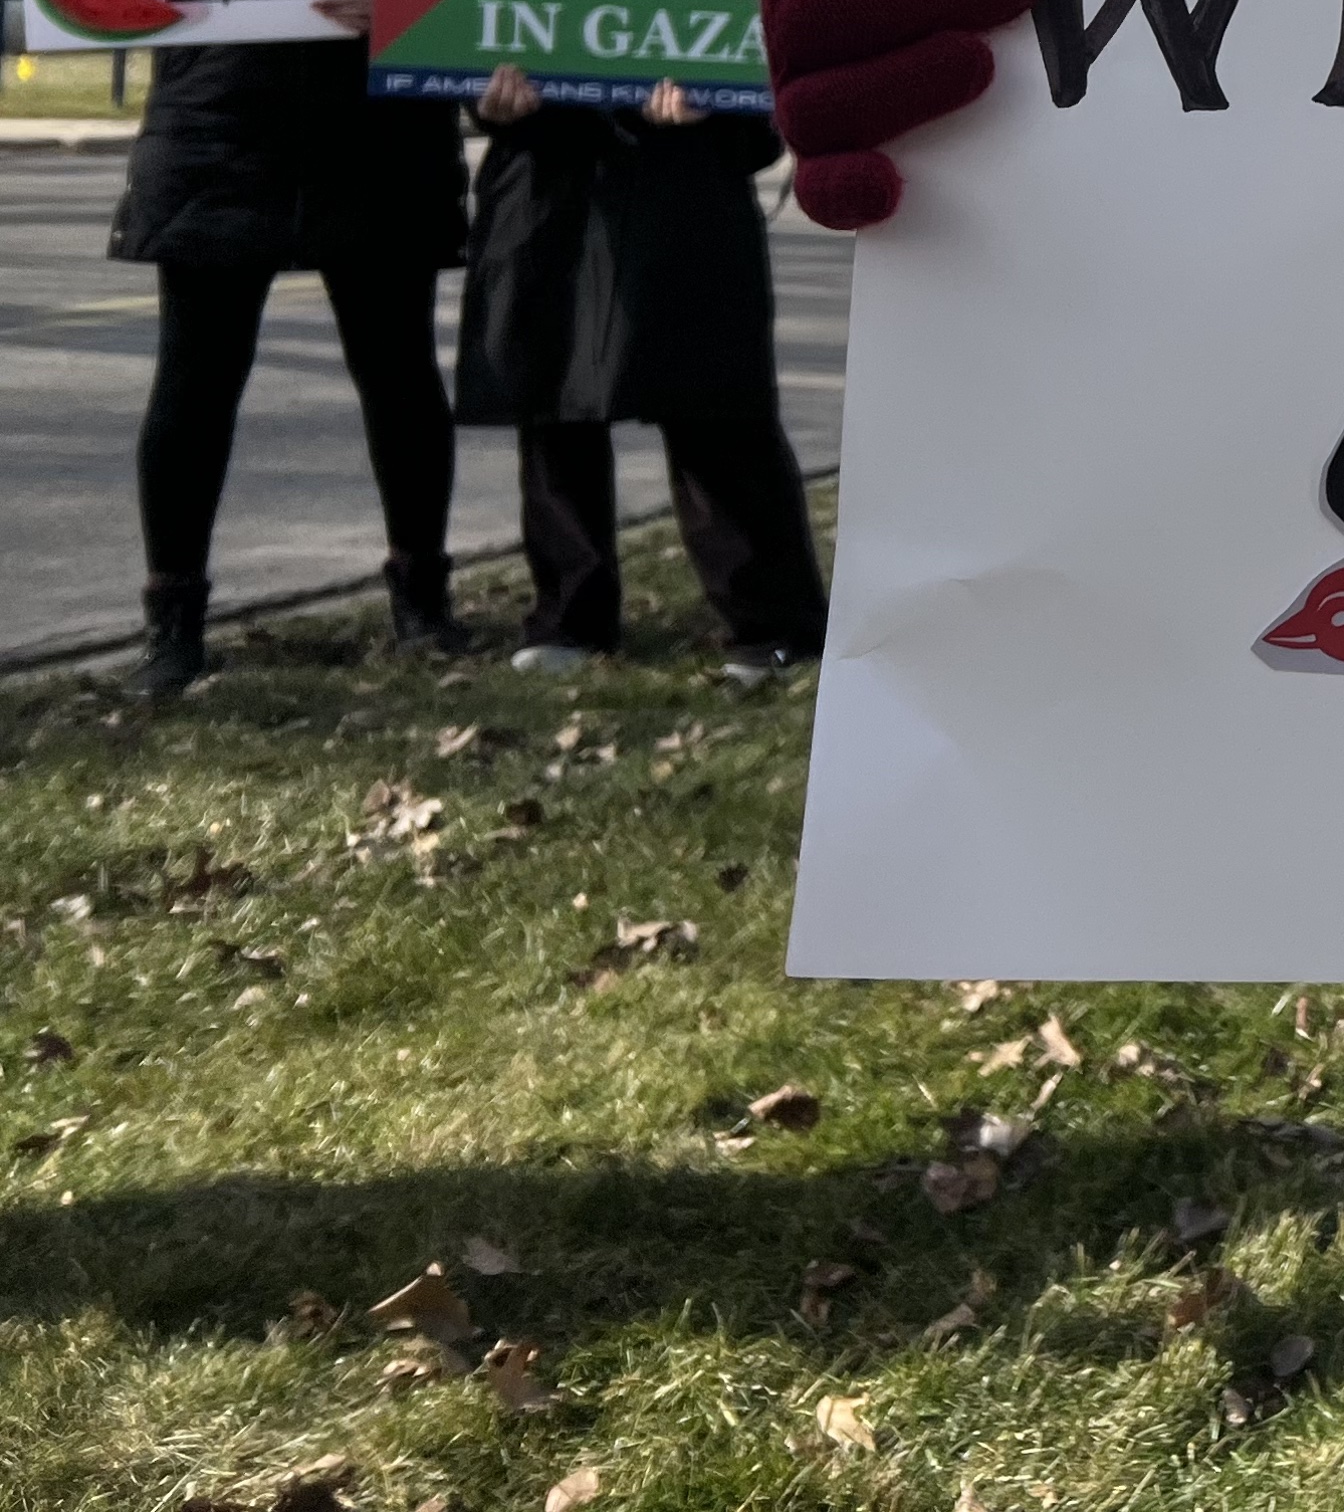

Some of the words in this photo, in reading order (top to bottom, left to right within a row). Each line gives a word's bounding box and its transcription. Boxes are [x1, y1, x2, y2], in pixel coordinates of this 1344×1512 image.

[477, 0, 563, 53] IN
[582, 3, 769, 64] GAZA
[386, 72, 414, 93] IF
[421, 74, 602, 103] AMEANS
